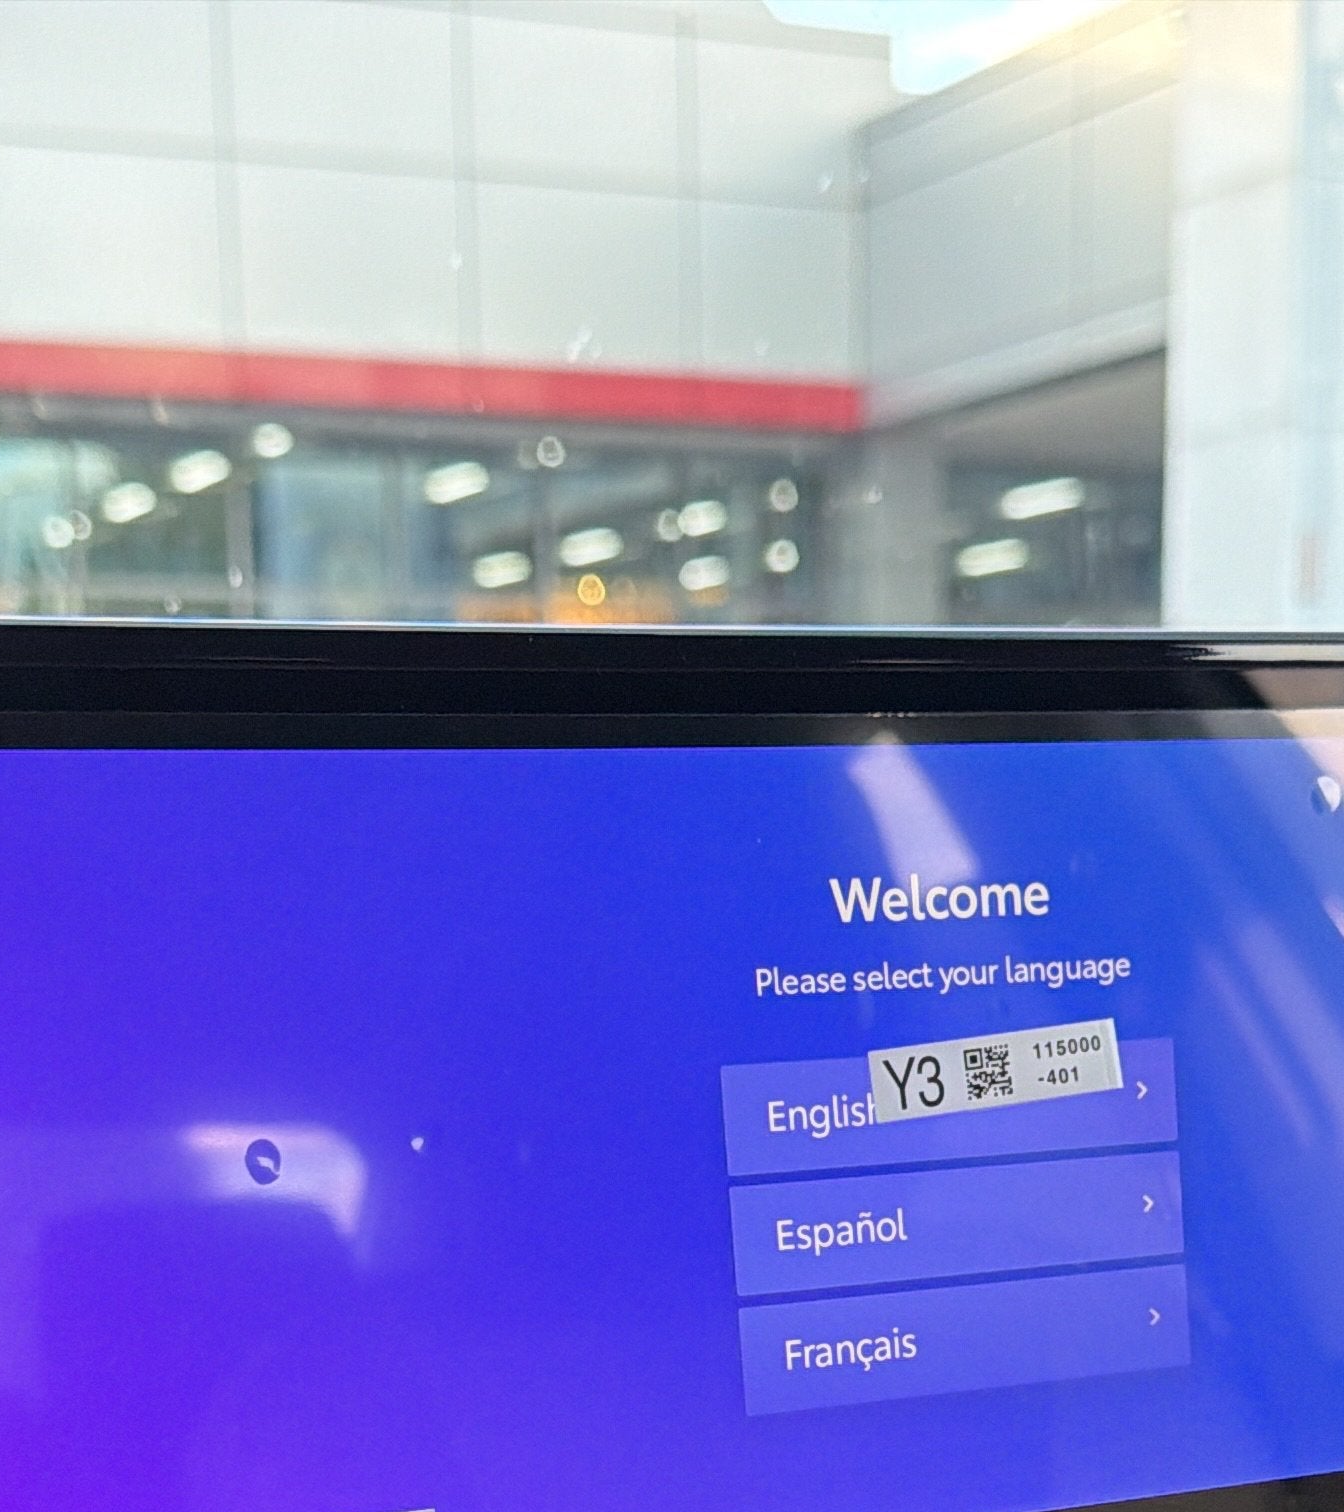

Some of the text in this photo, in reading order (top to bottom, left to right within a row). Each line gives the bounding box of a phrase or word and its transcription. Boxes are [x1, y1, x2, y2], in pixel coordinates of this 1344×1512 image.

[828, 873, 1050, 923] Welcome
[755, 956, 1131, 997] Please select your language
[1032, 1035, 1102, 1059] 115000
[882, 1055, 945, 1110] Y3
[1038, 1066, 1080, 1085] -401
[775, 1208, 908, 1256] Español
[784, 1328, 917, 1371] Français
